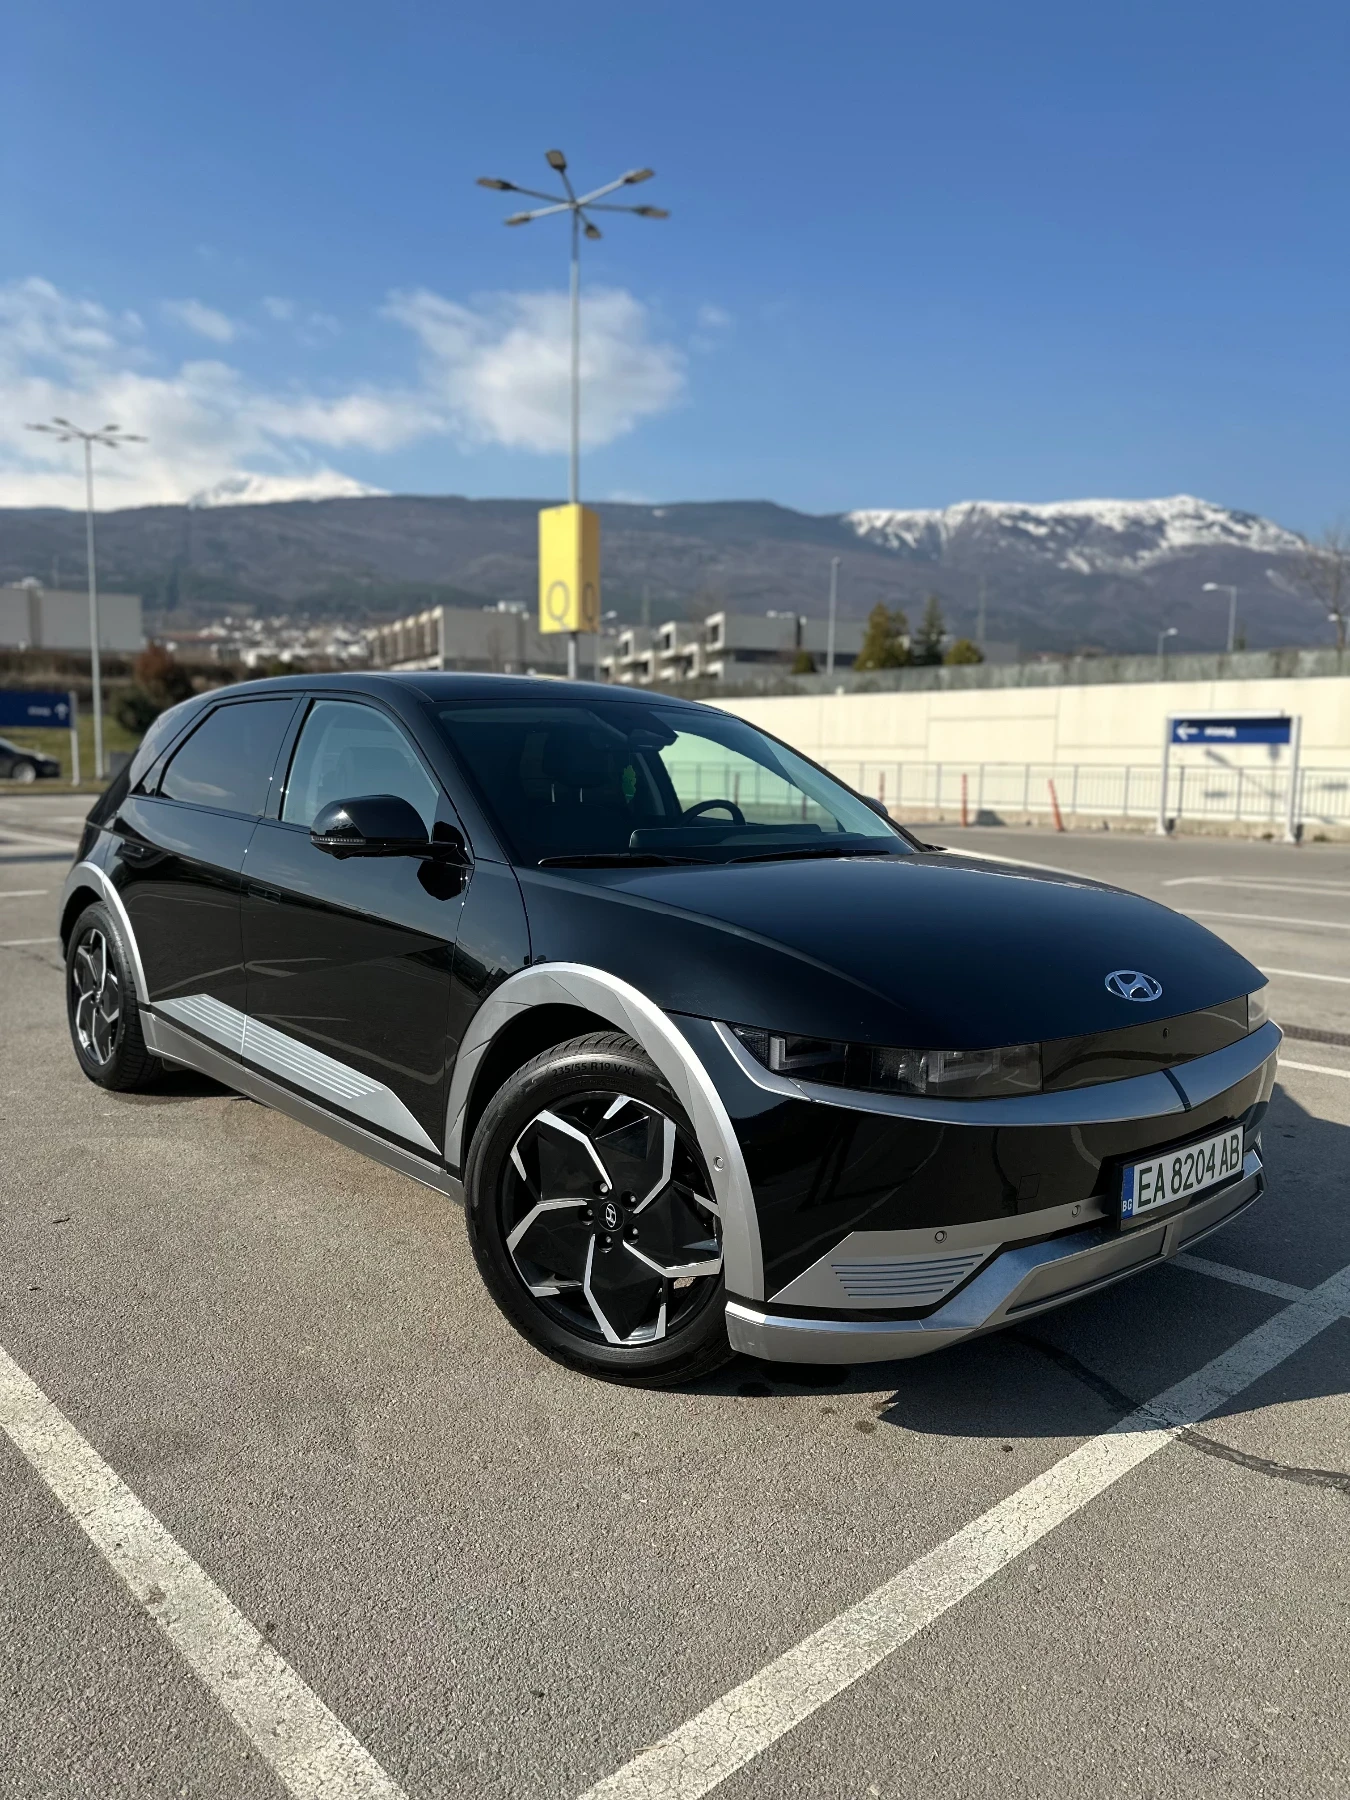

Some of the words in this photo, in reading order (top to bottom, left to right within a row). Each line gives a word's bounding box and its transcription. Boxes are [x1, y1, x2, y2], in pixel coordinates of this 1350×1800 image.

[552, 1062, 587, 1077] 235/55
[613, 1063, 622, 1073] V
[623, 1065, 637, 1077] XL
[1137, 1162, 1166, 1208] EA
[1170, 1143, 1216, 1195] 8204
[1218, 1133, 1240, 1176] AB
[1122, 1198, 1133, 1213] BG
